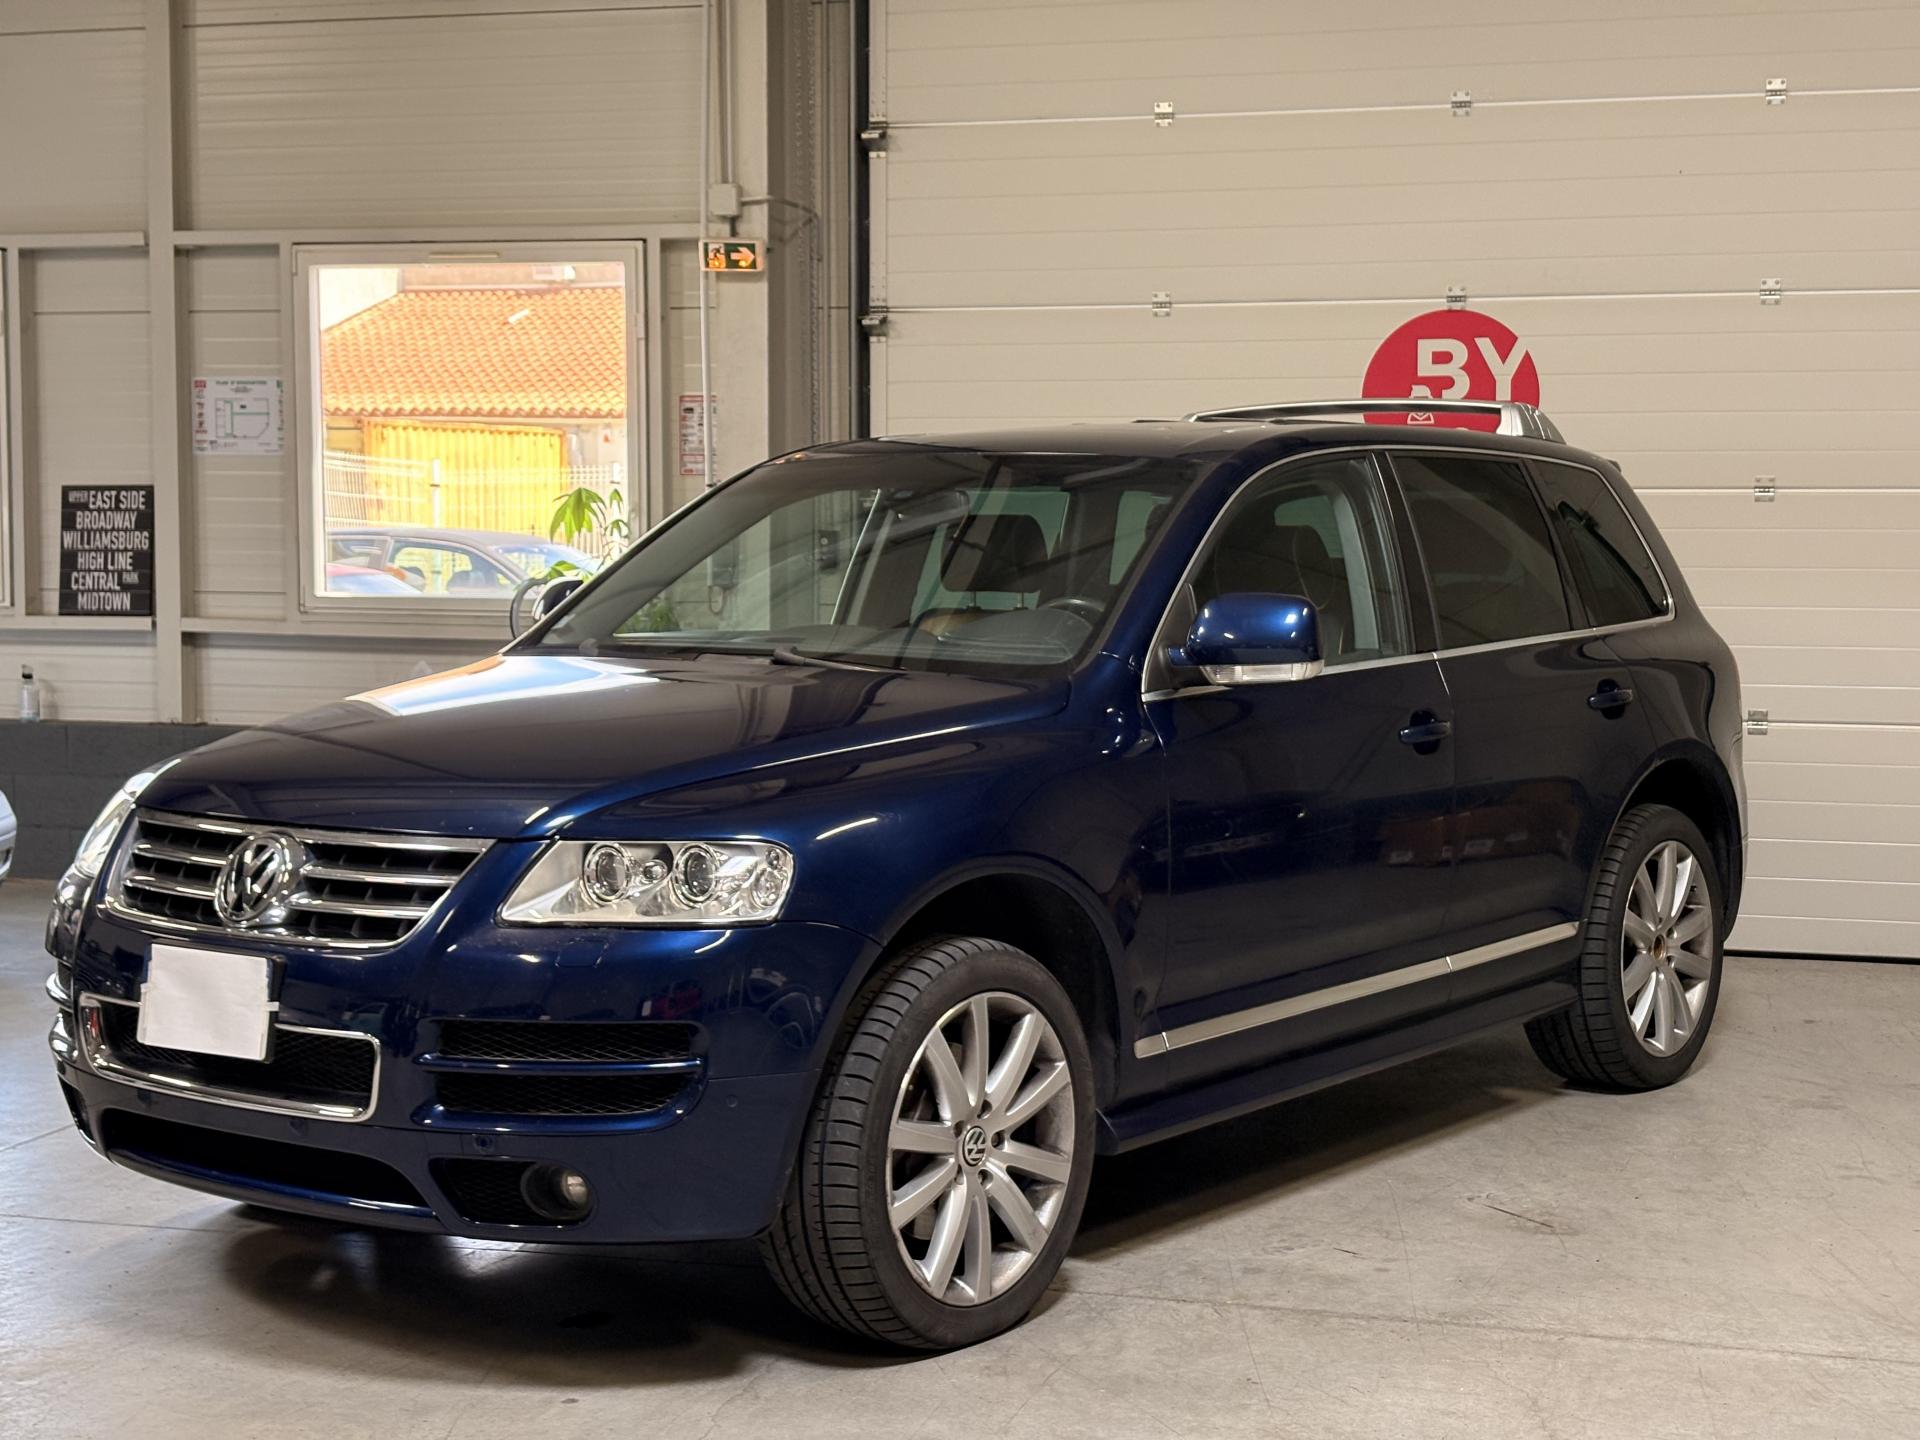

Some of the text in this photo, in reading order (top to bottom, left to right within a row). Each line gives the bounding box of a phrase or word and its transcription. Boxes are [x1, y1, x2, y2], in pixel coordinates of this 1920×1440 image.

[1417, 337, 1527, 400] BY
[89, 490, 118, 509] EAST
[120, 490, 146, 509] SIDE
[76, 510, 138, 530] BROADWAY
[63, 530, 149, 550] WILLIAMSBURG
[77, 551, 133, 570] HIGH LINE
[71, 571, 121, 590] CENTRAL
[78, 591, 131, 611] MIDTOWN
